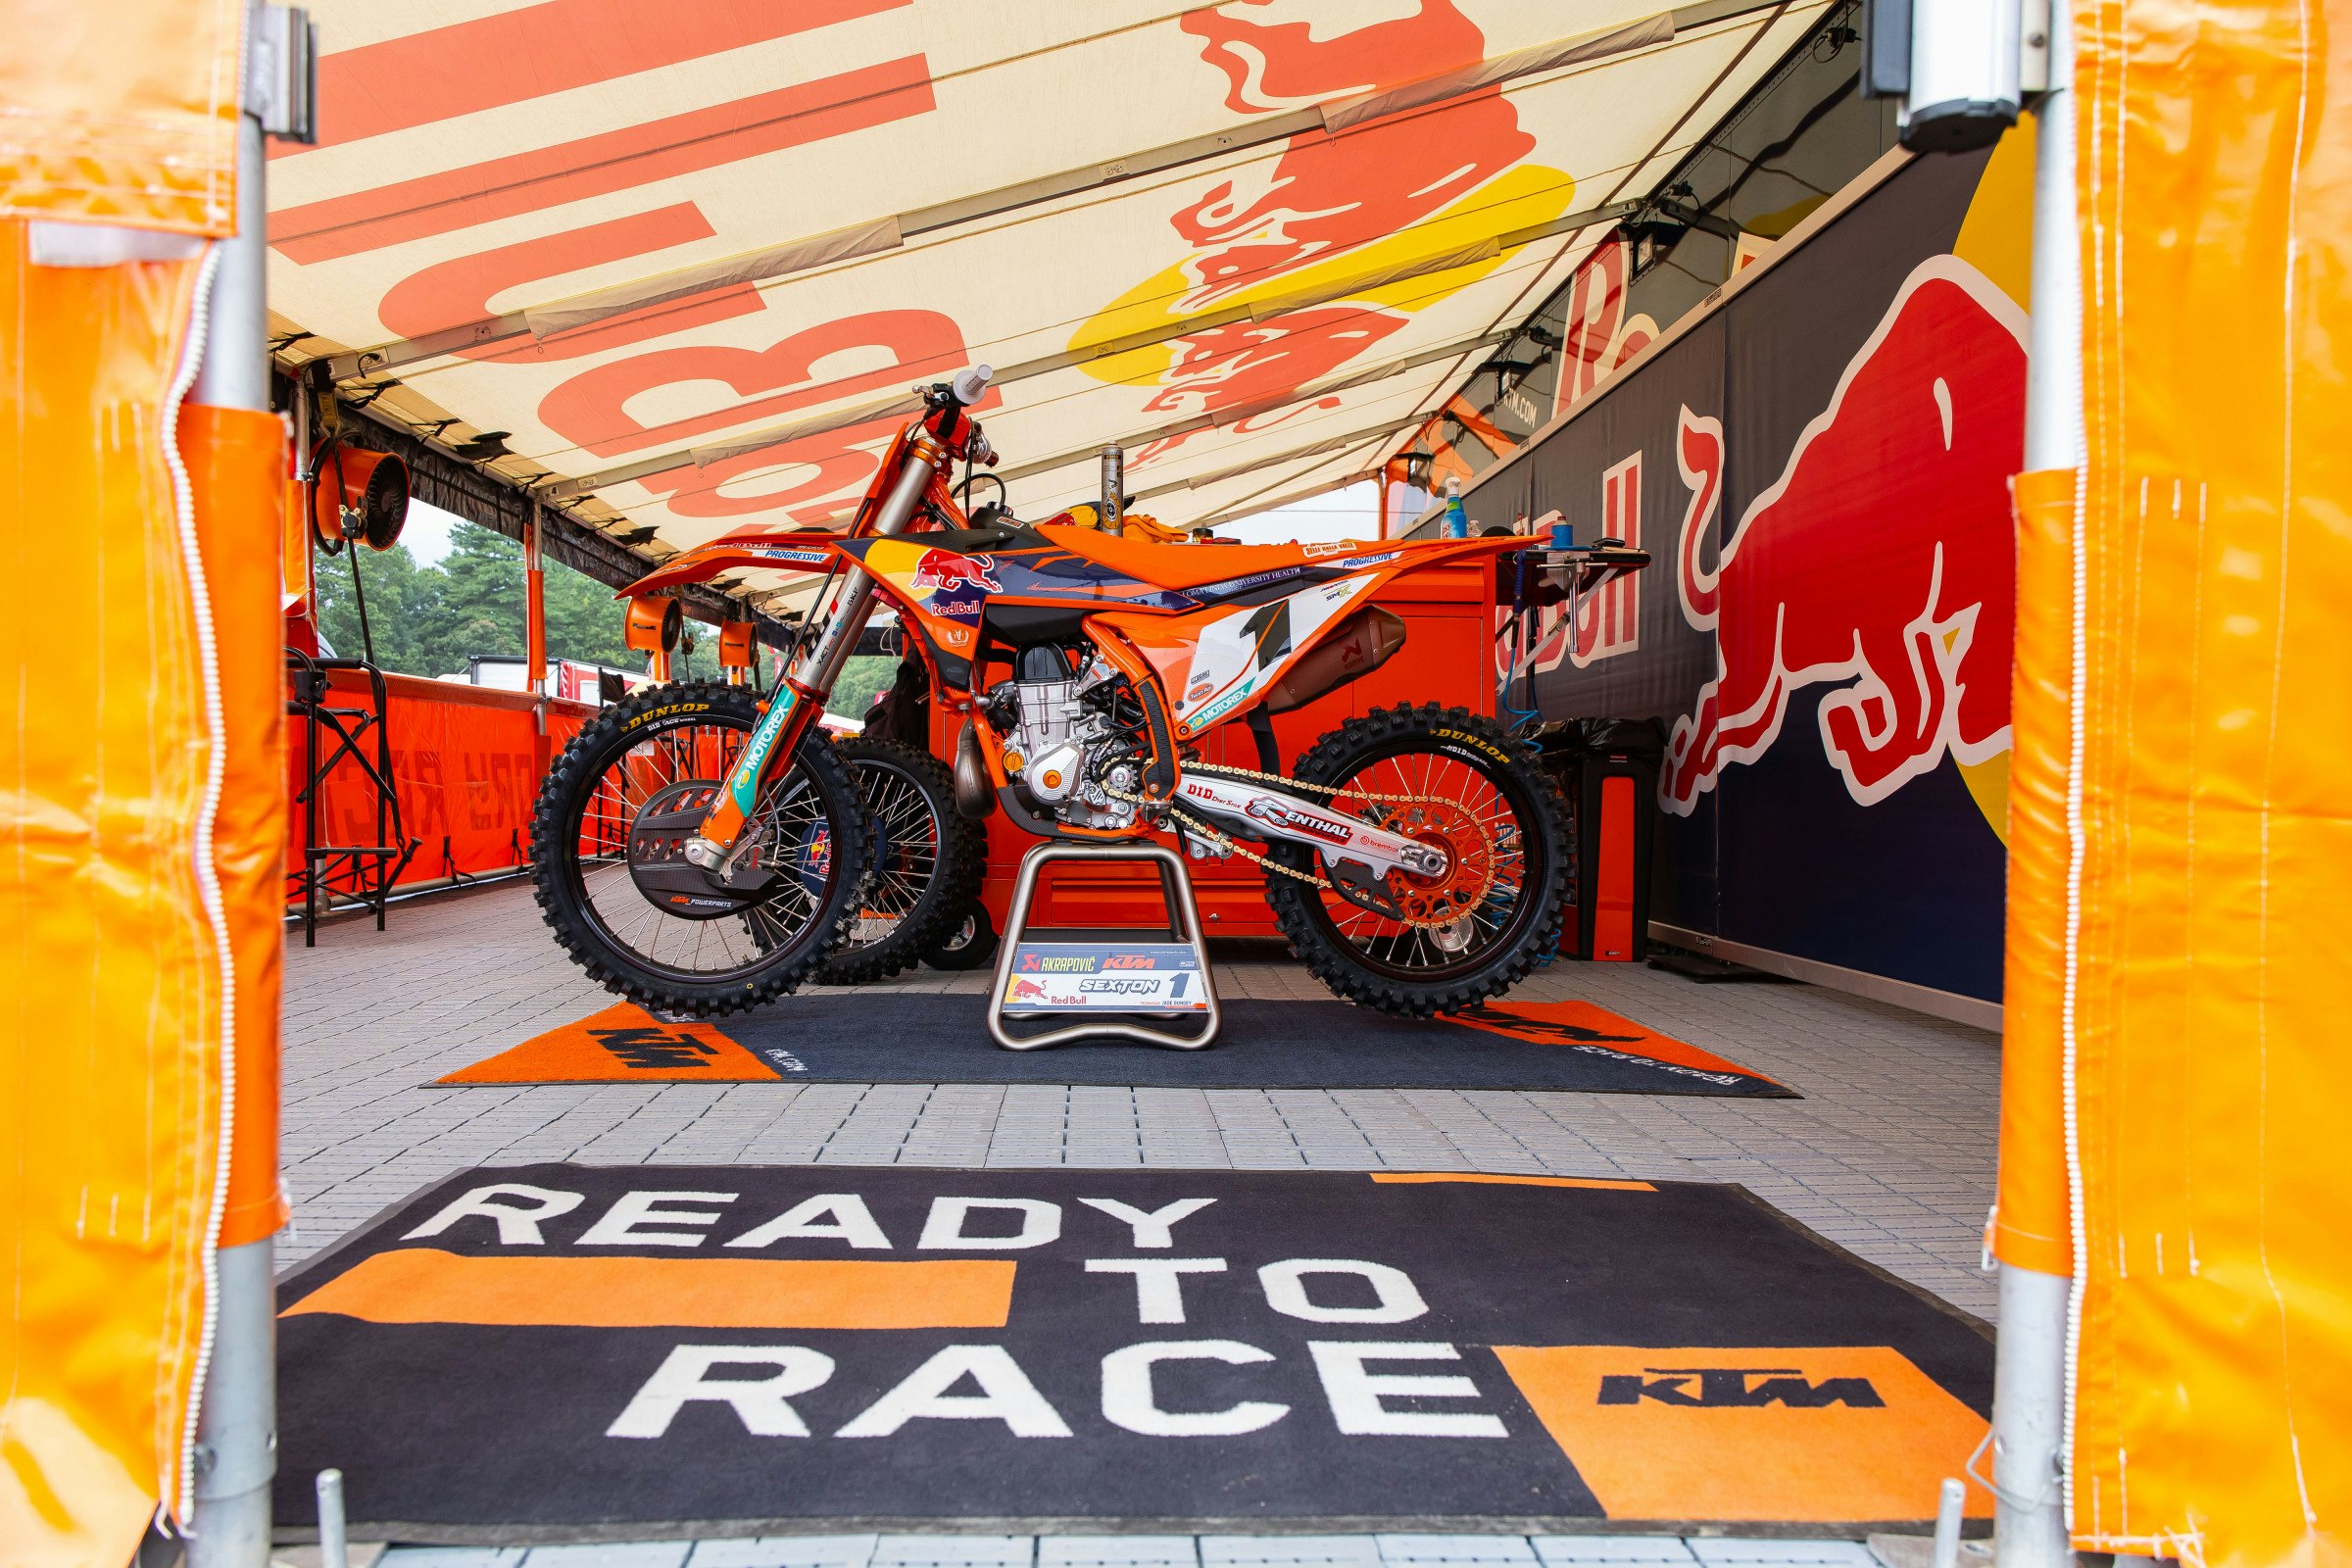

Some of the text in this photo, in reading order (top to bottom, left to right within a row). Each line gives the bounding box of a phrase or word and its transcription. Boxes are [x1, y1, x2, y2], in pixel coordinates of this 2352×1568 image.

[765, 550, 825, 562] PROGRESSIVE
[1343, 553, 1393, 567] PROGRESSIVE
[1182, 586, 1205, 599] LOMA
[1228, 573, 1272, 590] UNIVERSITY
[1271, 566, 1301, 579] HEALTH
[931, 600, 980, 616] Red Bull
[1240, 599, 1292, 673] 1
[629, 703, 710, 730] DUNLOP
[1201, 687, 1248, 722] MOTOREX
[745, 704, 790, 771] MOTOREX
[1436, 728, 1511, 764] DUNLOP
[1187, 783, 1213, 800] DID
[1369, 839, 1397, 853] brembo
[669, 895, 732, 907] KTM POWERPARTS
[1041, 956, 1096, 972] AKRAPOVIČ
[1101, 954, 1156, 969] KTM
[1078, 978, 1161, 996] SEXTON
[1169, 972, 1190, 998] 1
[1051, 995, 1087, 1005] Red Bull
[588, 1026, 723, 1069] KTM
[400, 1183, 1217, 1250] READY
[1085, 1258, 1429, 1325] TO
[605, 1339, 1510, 1440] RACE
[1599, 1369, 1885, 1407] KTM
